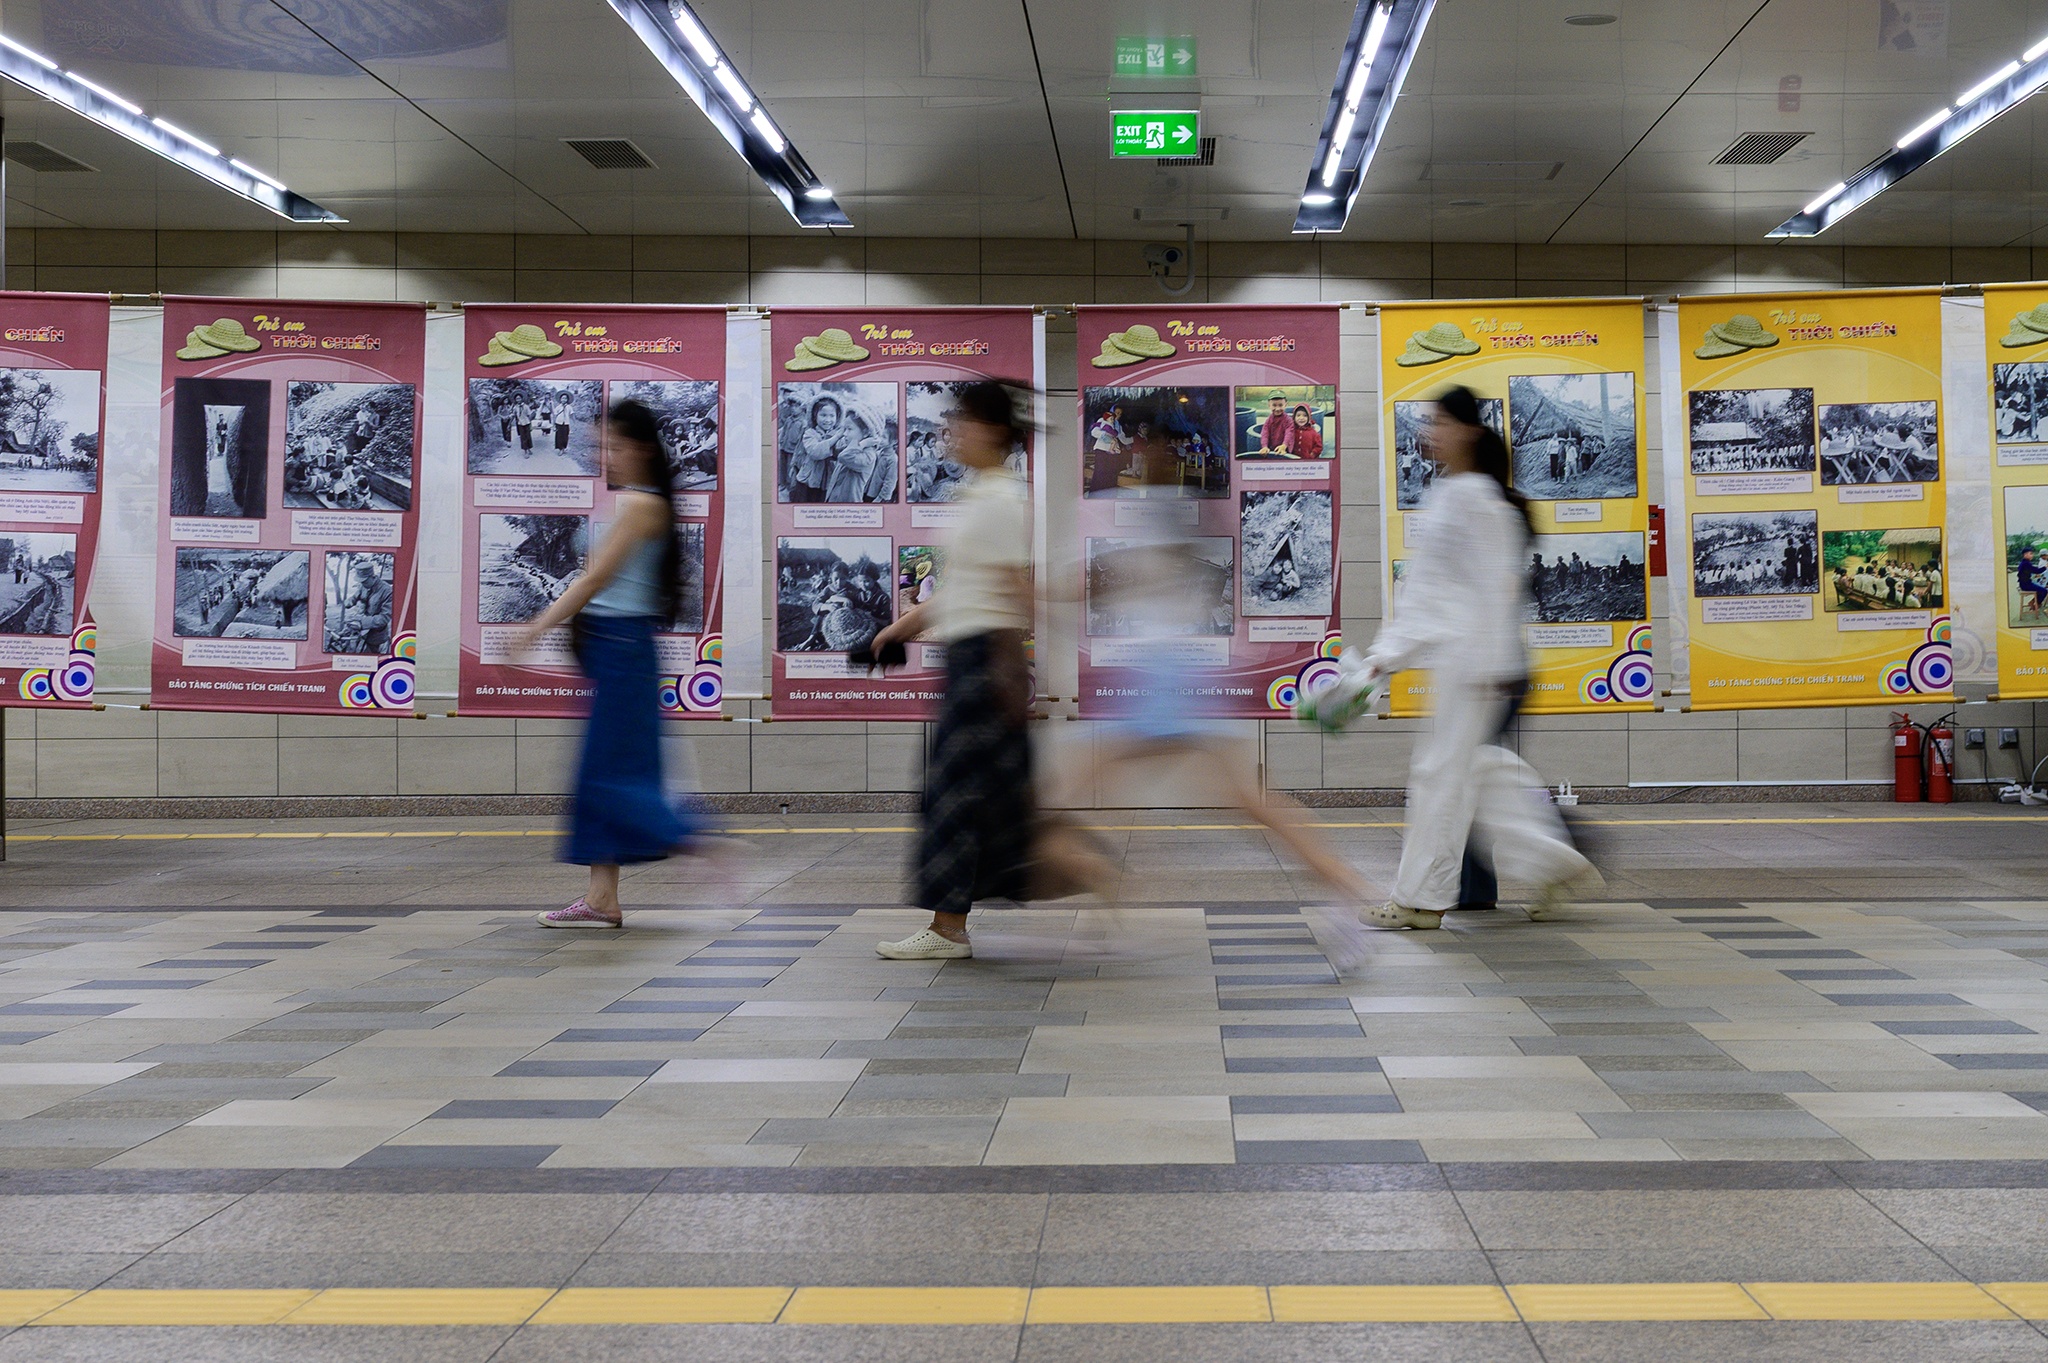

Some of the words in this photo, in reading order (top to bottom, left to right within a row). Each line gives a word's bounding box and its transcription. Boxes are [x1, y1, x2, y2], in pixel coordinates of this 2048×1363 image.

[1116, 125, 1142, 136] EXIT
[253, 315, 280, 332] Trẻ
[283, 322, 306, 332] em
[554, 320, 582, 337] Trẻ
[584, 326, 607, 336] em
[1166, 320, 1194, 337] Trẻ
[1197, 325, 1220, 336] em
[1788, 324, 1834, 340] THỜI
[1838, 320, 1897, 338] CHIẾN
[5, 325, 65, 343] CHIẾN
[860, 324, 888, 340] Trẻ
[891, 328, 914, 339] em
[1489, 334, 1535, 349] THỜI
[1540, 330, 1599, 348] CHIẾN
[270, 333, 316, 348] THỜI
[321, 334, 381, 350] CHIẾN
[572, 337, 618, 352] THỜI
[623, 336, 682, 352] CHIẾN
[878, 340, 925, 356] THỜI
[930, 338, 989, 356] CHIẾN
[1184, 336, 1232, 352] THỜI
[1236, 335, 1296, 352] CHIẾN
[168, 678, 187, 689] BẢO
[189, 680, 212, 689] TÀNG
[214, 680, 244, 690] CHỨNG
[246, 681, 266, 691] TÍCH
[268, 682, 294, 692] CHIẾN
[297, 684, 326, 693] TRANH
[1836, 674, 1865, 683] TRANH
[476, 685, 494, 695] BẢO
[496, 686, 520, 695] TÀNG
[521, 686, 551, 696] CHỨNG
[553, 686, 573, 696] TÍCH
[790, 689, 808, 700] BẢO
[810, 690, 833, 700] TÀNG
[835, 689, 865, 700] CHỨNG
[867, 689, 886, 700] TÍCH
[888, 689, 915, 700] CHIẾN
[918, 691, 946, 700] TRANH
[1096, 686, 1114, 697] BẢO
[1116, 687, 1139, 697] TÀNG
[1196, 685, 1222, 696] CHIẾN
[1224, 688, 1254, 696] TRANH
[1536, 683, 1566, 691] TRANH
